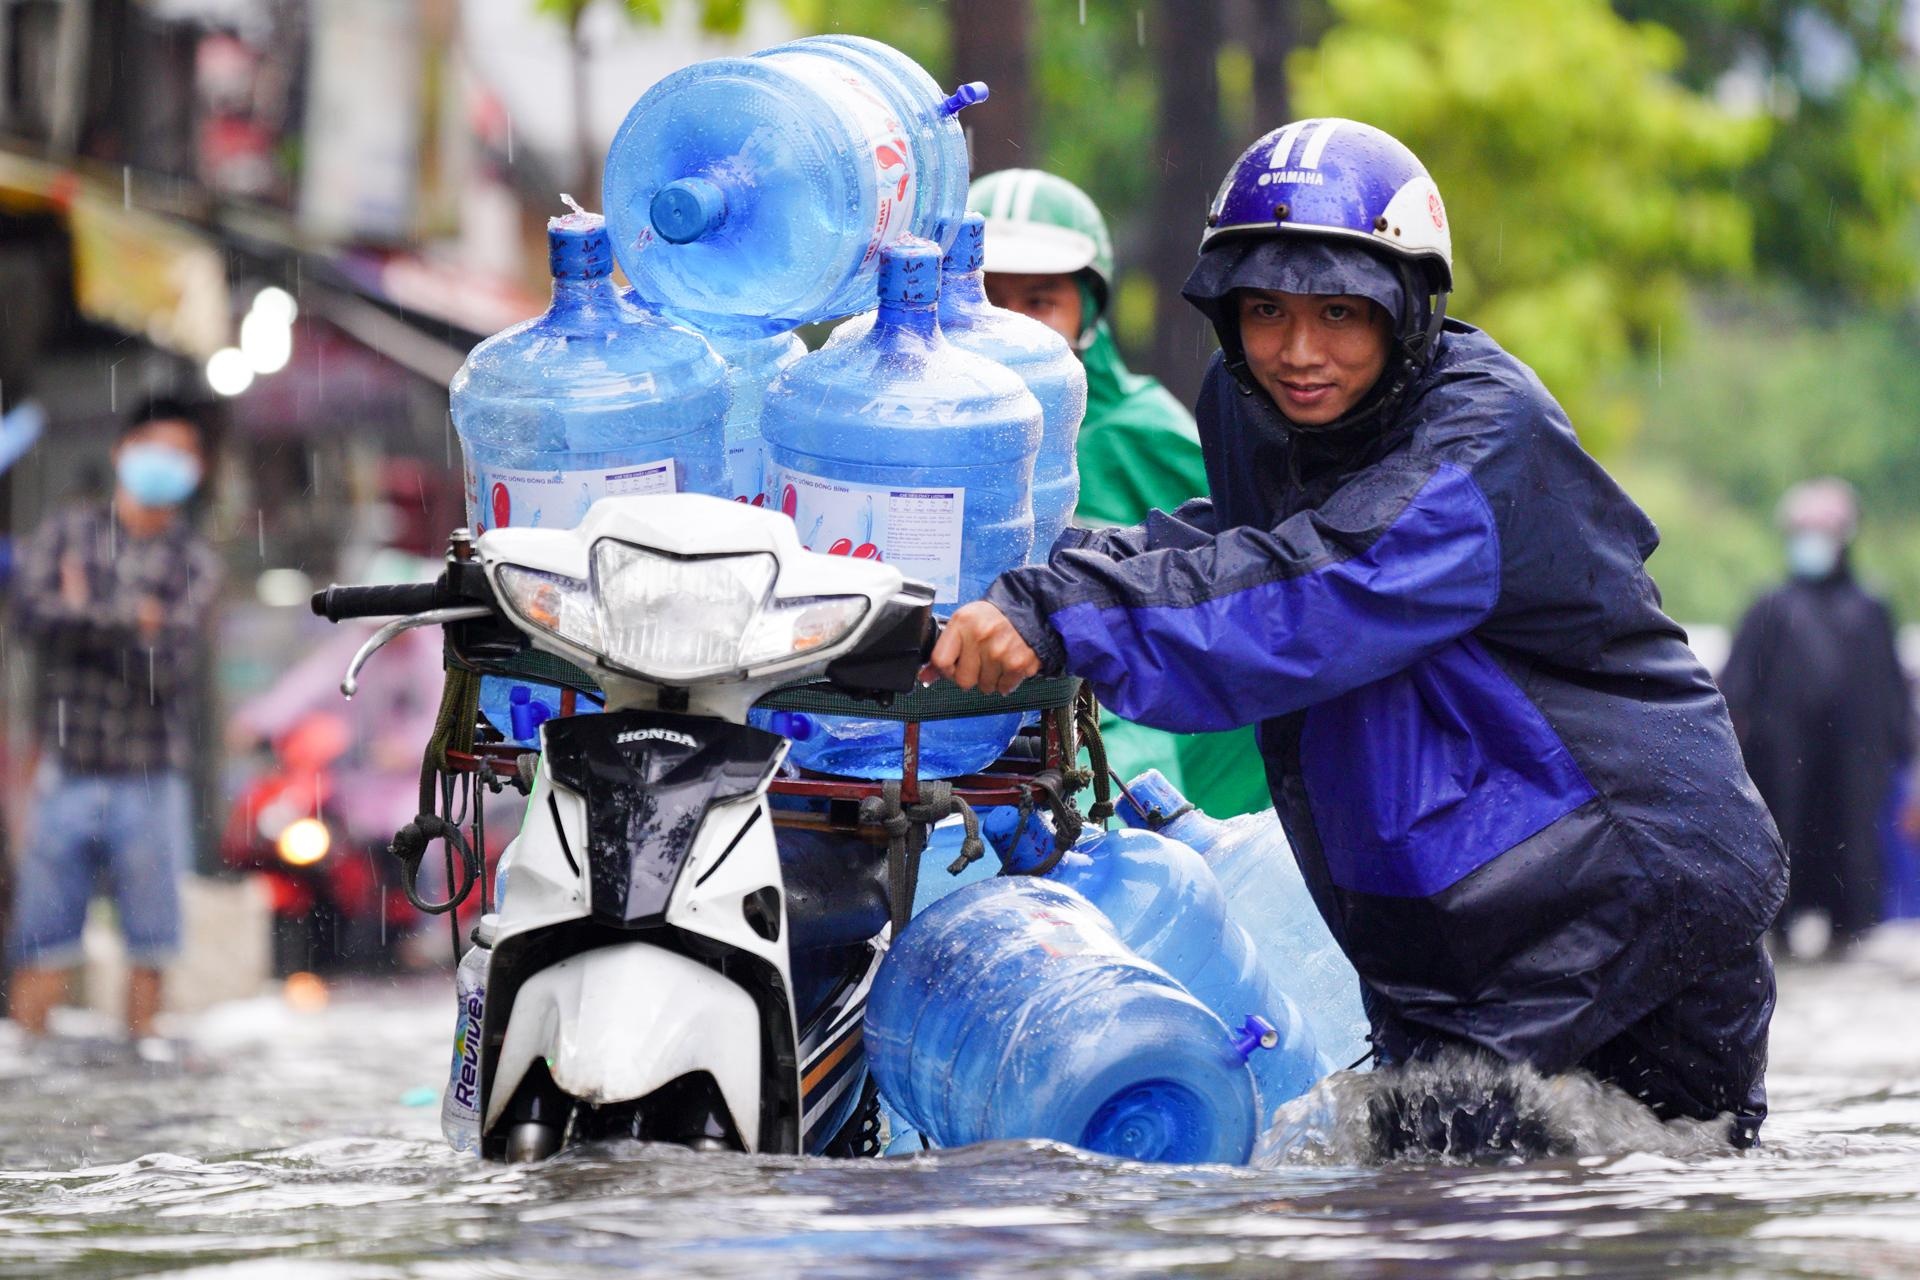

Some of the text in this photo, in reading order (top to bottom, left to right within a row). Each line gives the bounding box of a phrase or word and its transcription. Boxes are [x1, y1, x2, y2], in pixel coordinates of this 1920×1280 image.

[1272, 172, 1323, 185] YAMAHA
[617, 728, 697, 748] HONDA
[455, 997, 484, 1108] Revive
